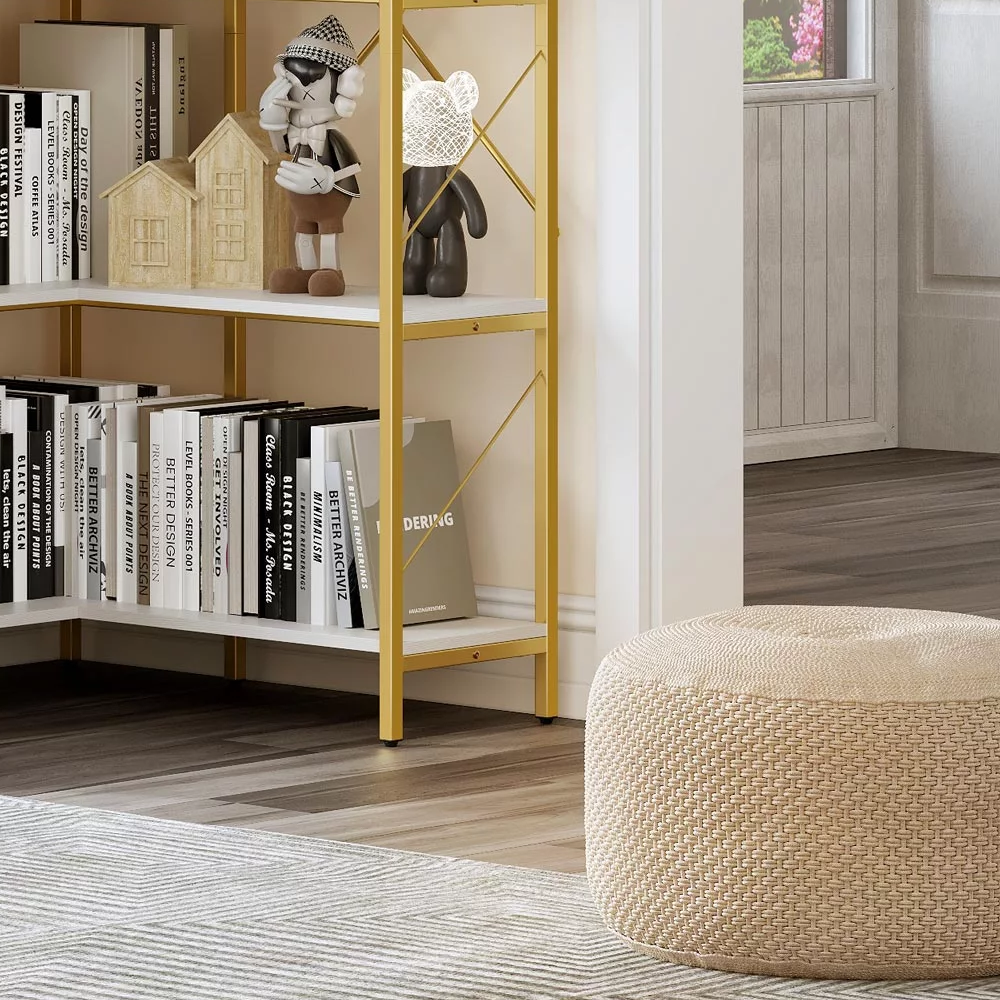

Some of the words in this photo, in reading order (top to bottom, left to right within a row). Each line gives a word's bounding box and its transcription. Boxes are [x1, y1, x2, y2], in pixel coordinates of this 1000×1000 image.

[62, 110, 71, 142] Class
[78, 127, 88, 152] Day
[0, 148, 8, 187] BLACK
[62, 146, 71, 181] Room
[80, 158, 88, 172] of
[0, 193, 8, 238] DESIGN
[62, 197, 71, 219] Ms.
[79, 204, 88, 252] design
[62, 222, 71, 266] Posada
[2, 469, 11, 493] lets,
[17, 455, 26, 496] BLACK
[88, 466, 98, 513] BETTER
[138, 472, 148, 497] THE
[166, 458, 175, 508] BETTER
[283, 475, 293, 516] BLACK
[346, 470, 353, 481] BE
[3, 496, 11, 527] clean
[46, 503, 52, 515] OF
[138, 502, 148, 539] NEXT
[329, 490, 342, 539] BETTER
[348, 485, 358, 521] BETTER
[3, 530, 11, 550] the
[17, 503, 26, 550] DESIGN
[88, 517, 98, 574] ARCHVIZ
[166, 513, 175, 568] DESIGN
[283, 523, 293, 570] DESIGN
[313, 491, 322, 563] MINIMALISM
[3, 552, 11, 568] air
[138, 544, 148, 596] DESIGN
[334, 542, 347, 601] ARCHVIZ
[353, 525, 368, 590] RENDERINGS
